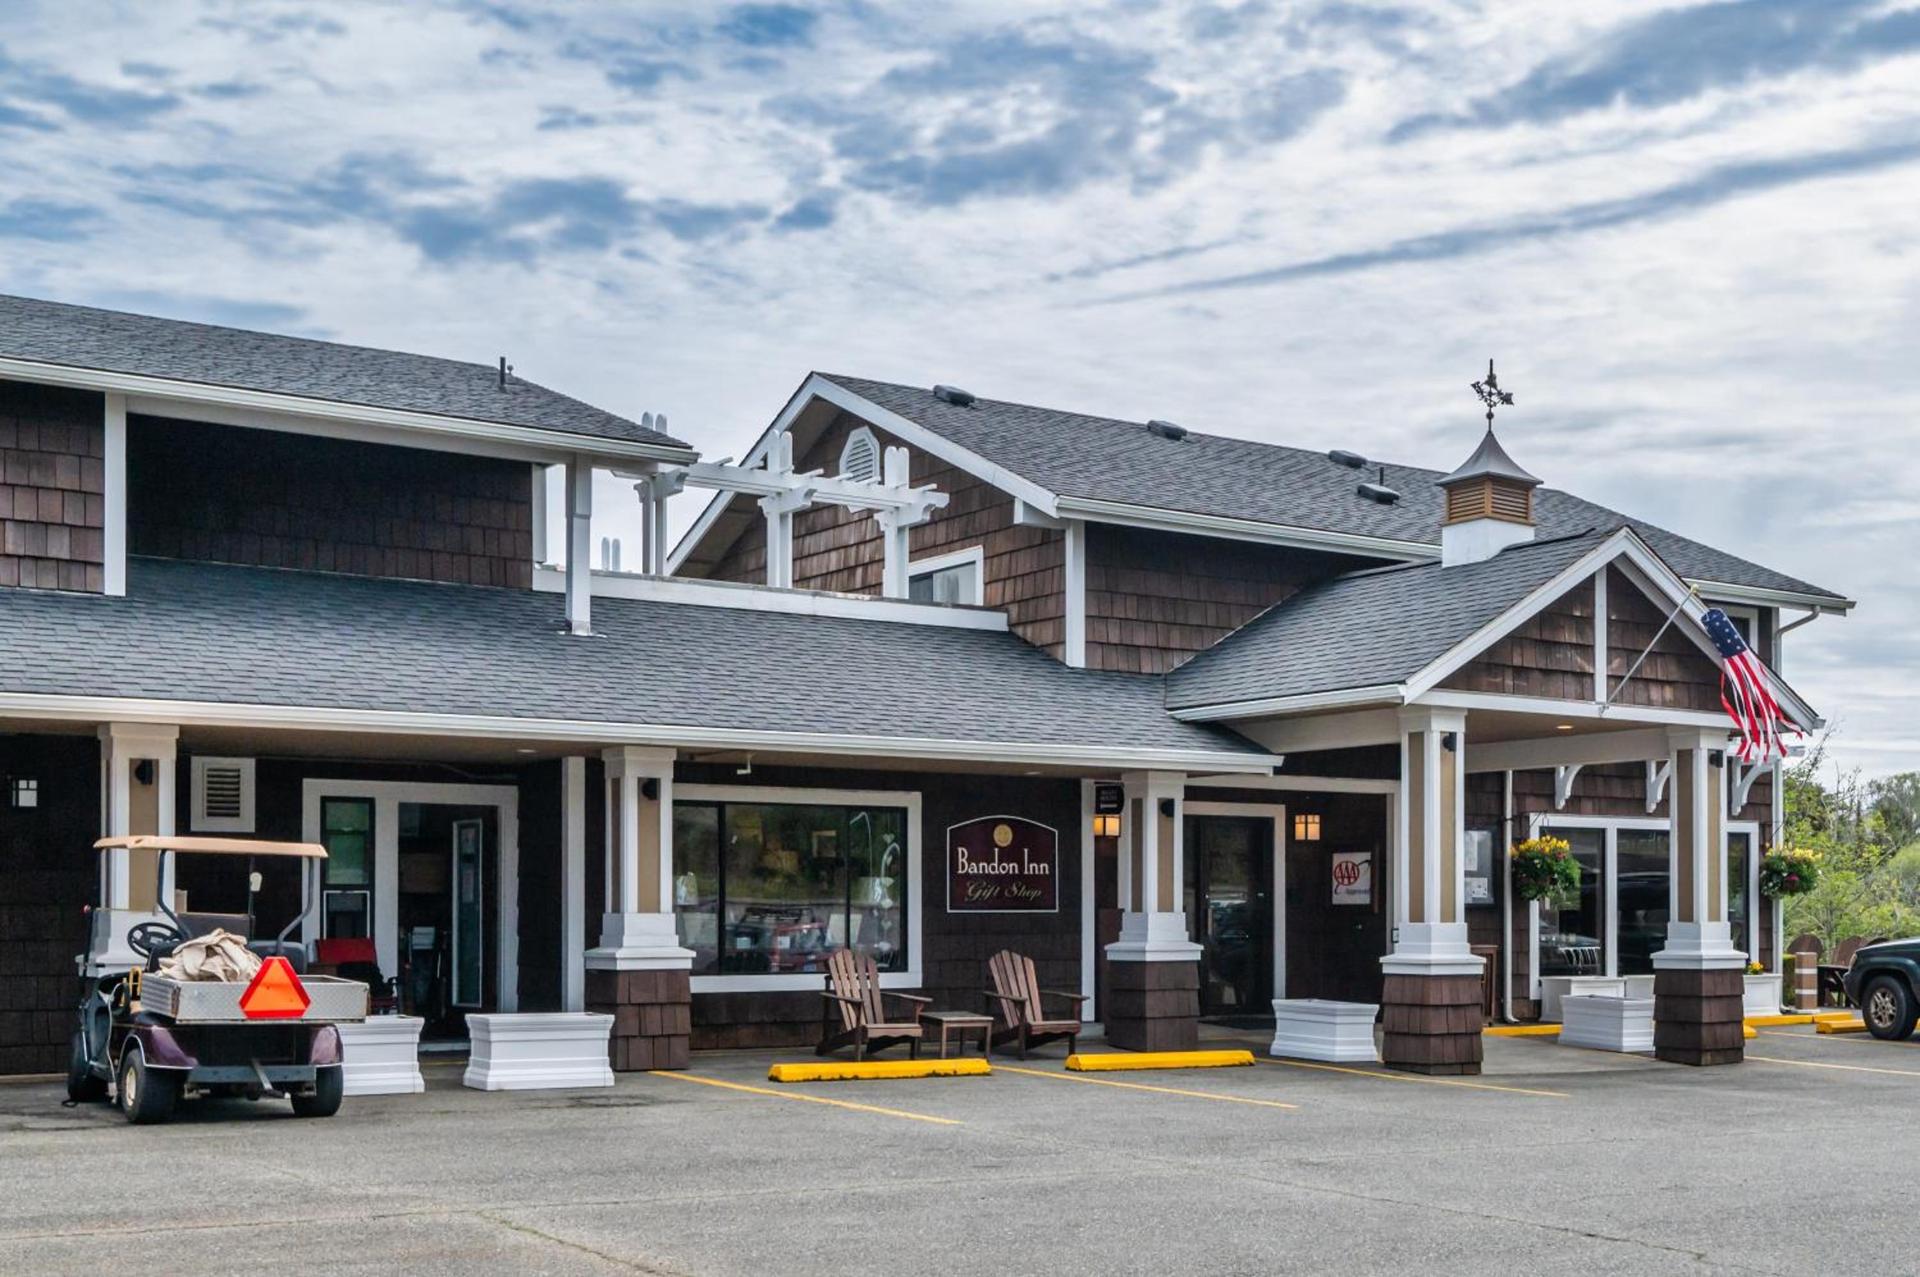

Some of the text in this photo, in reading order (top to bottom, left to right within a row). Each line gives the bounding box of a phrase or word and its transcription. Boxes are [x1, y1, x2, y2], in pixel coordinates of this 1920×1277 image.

[957, 846, 1050, 875] Bandon Inn
[964, 881, 1042, 902] Gift Shop
